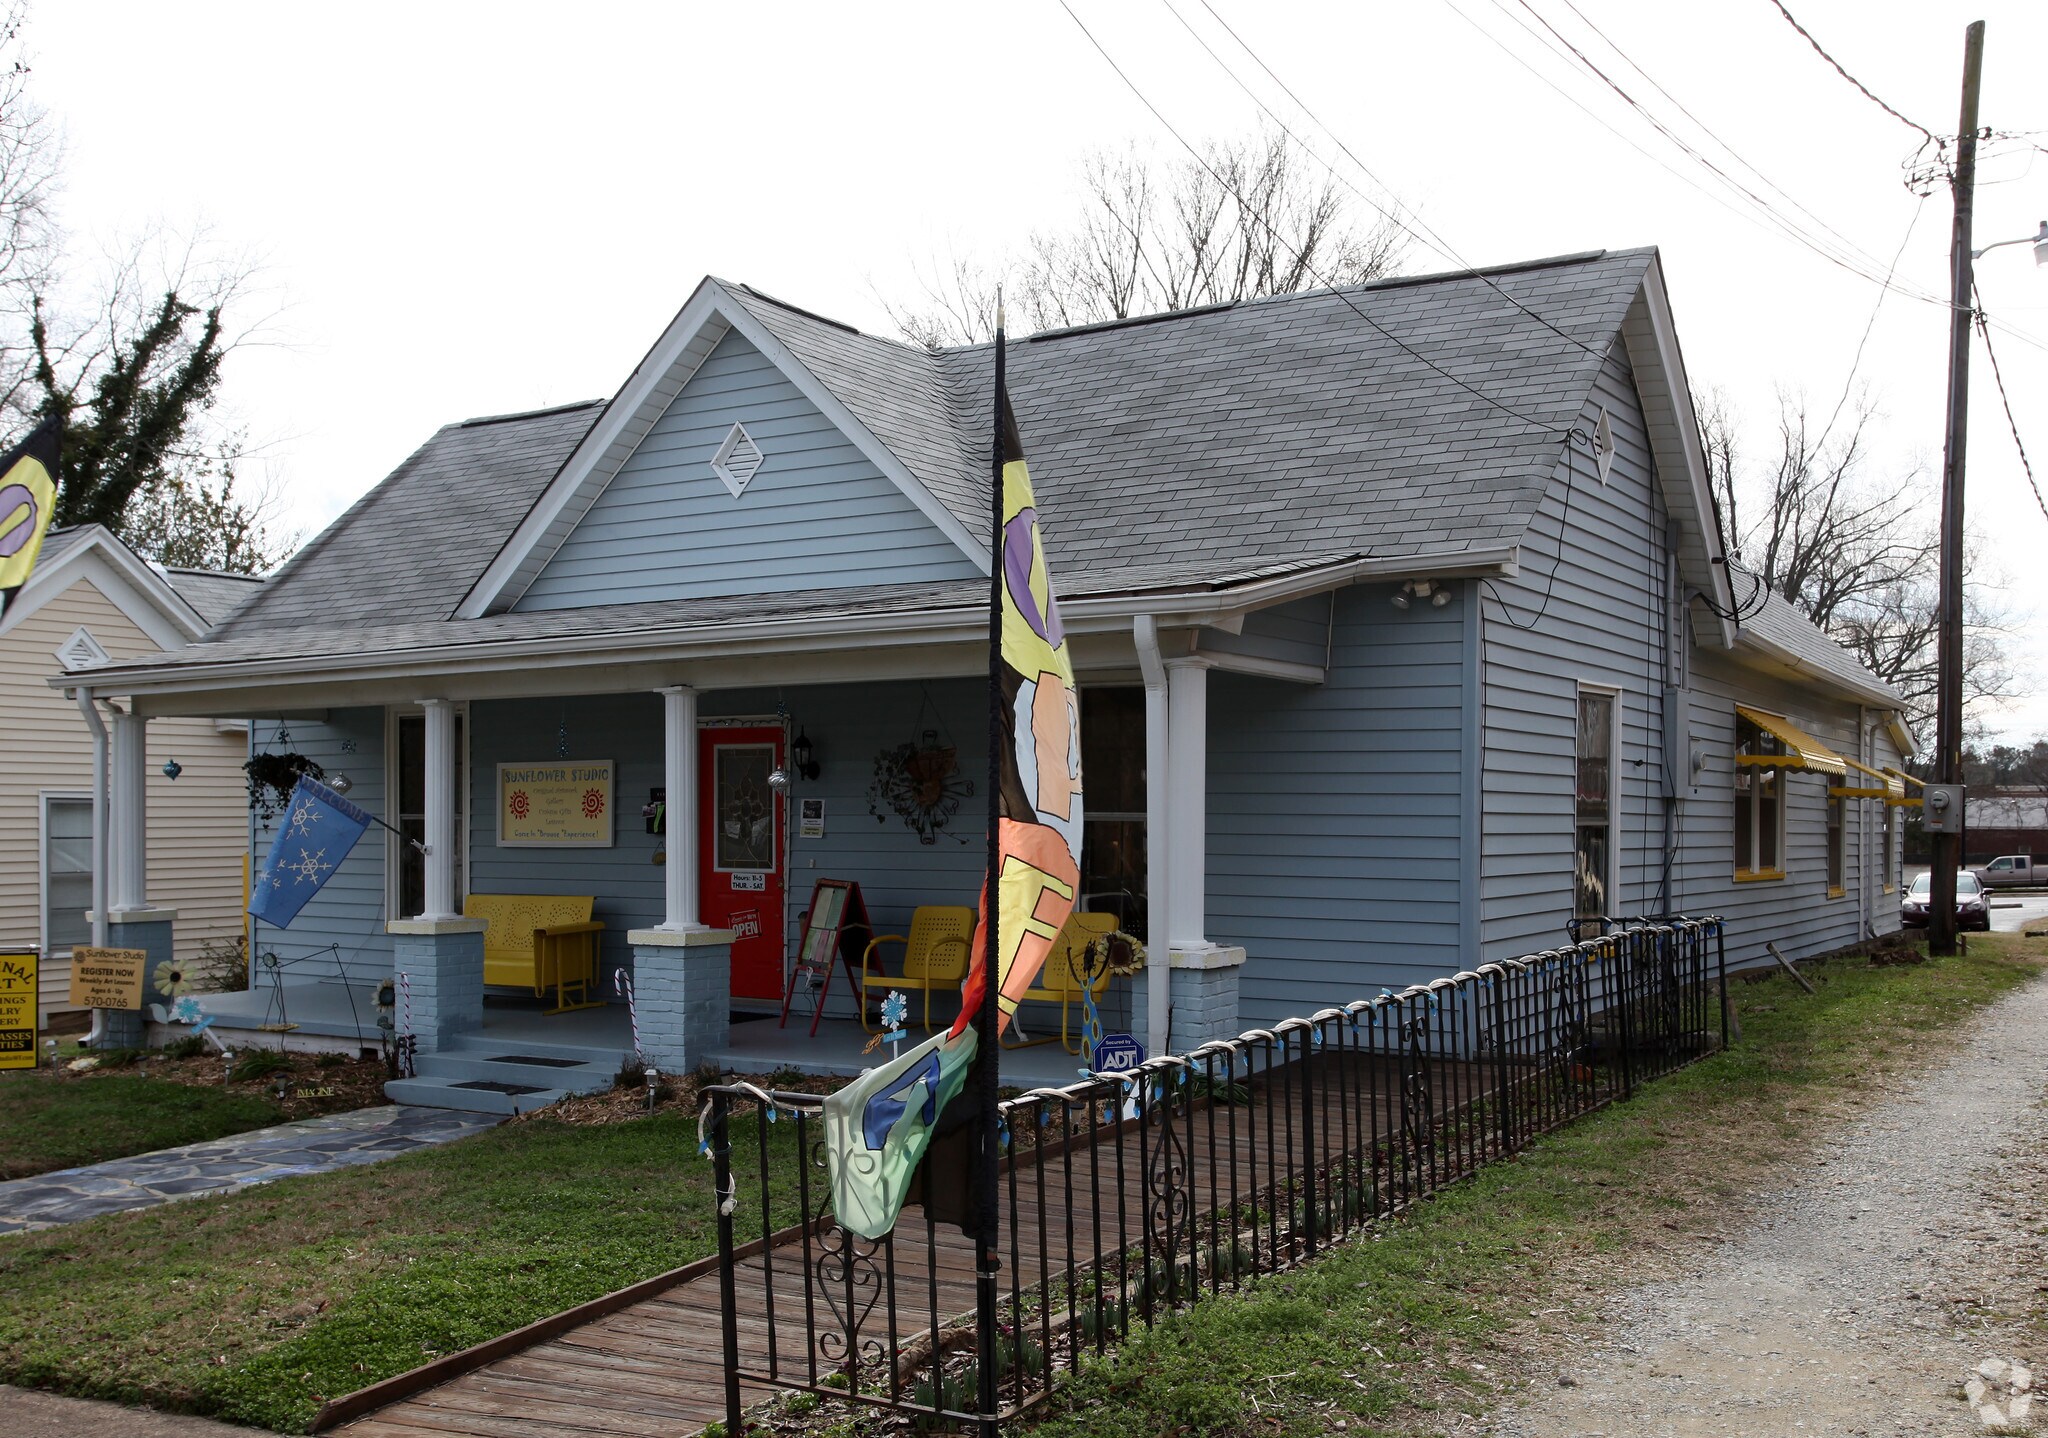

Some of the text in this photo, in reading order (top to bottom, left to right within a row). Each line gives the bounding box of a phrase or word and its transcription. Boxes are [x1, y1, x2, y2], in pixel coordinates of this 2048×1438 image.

[505, 769, 608, 783] SUNFLOWER STUDIO
[732, 921, 758, 937] OPEN
[86, 949, 144, 960] Sunflower Studio
[0, 961, 34, 984] NAL
[80, 967, 135, 977] REGISTER NOW
[0, 978, 16, 988] T
[79, 977, 102, 985] Weekly
[84, 996, 128, 1007] 570-0765
[1103, 1050, 1137, 1070] ADT
